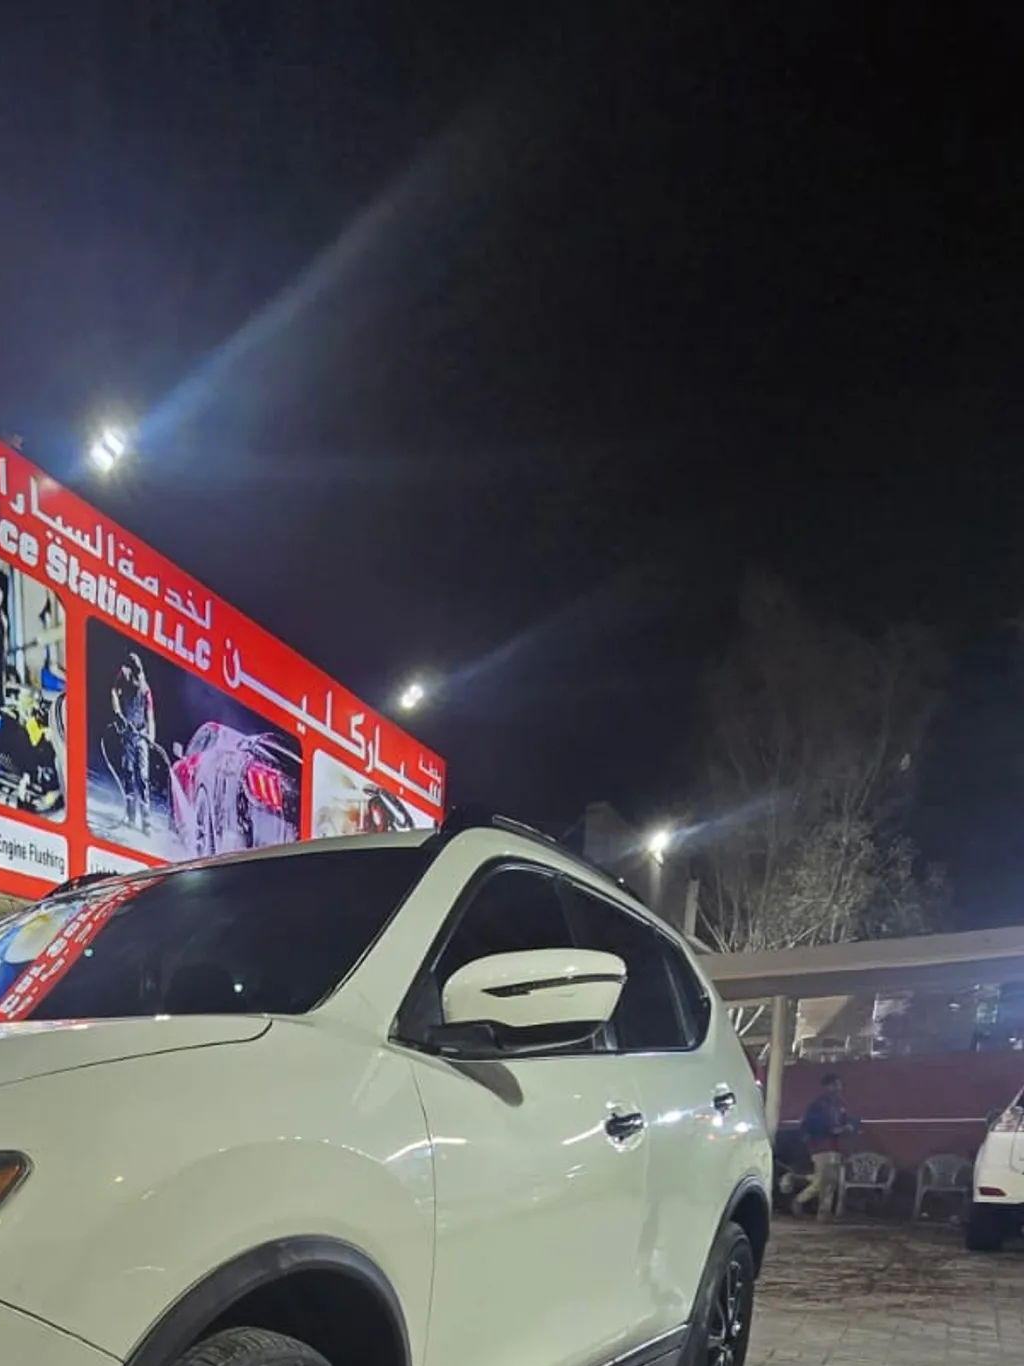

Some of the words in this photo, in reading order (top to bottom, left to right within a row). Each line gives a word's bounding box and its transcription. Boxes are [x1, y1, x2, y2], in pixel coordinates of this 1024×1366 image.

[45, 543, 149, 636] Station
[154, 610, 211, 671] L.L.C
[29, 842, 65, 875] Flushing
